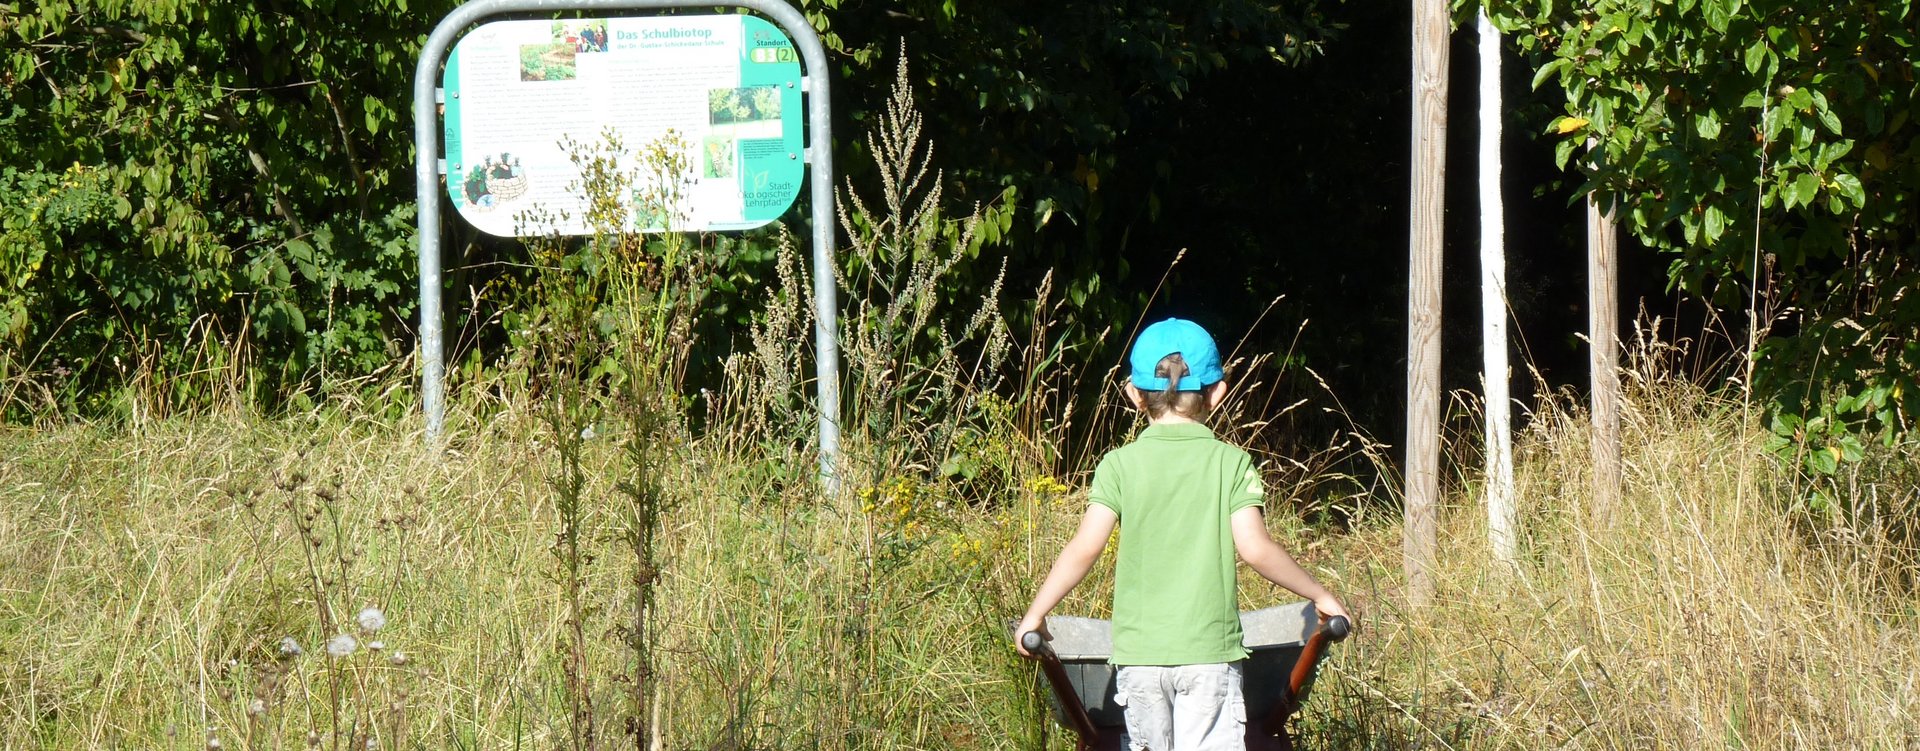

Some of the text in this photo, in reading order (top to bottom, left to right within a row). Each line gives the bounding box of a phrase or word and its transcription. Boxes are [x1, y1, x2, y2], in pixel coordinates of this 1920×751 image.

[616, 27, 712, 40] Das Schulbiotop
[769, 181, 793, 190] Stadt-
[745, 198, 782, 208] Lehrpfad
